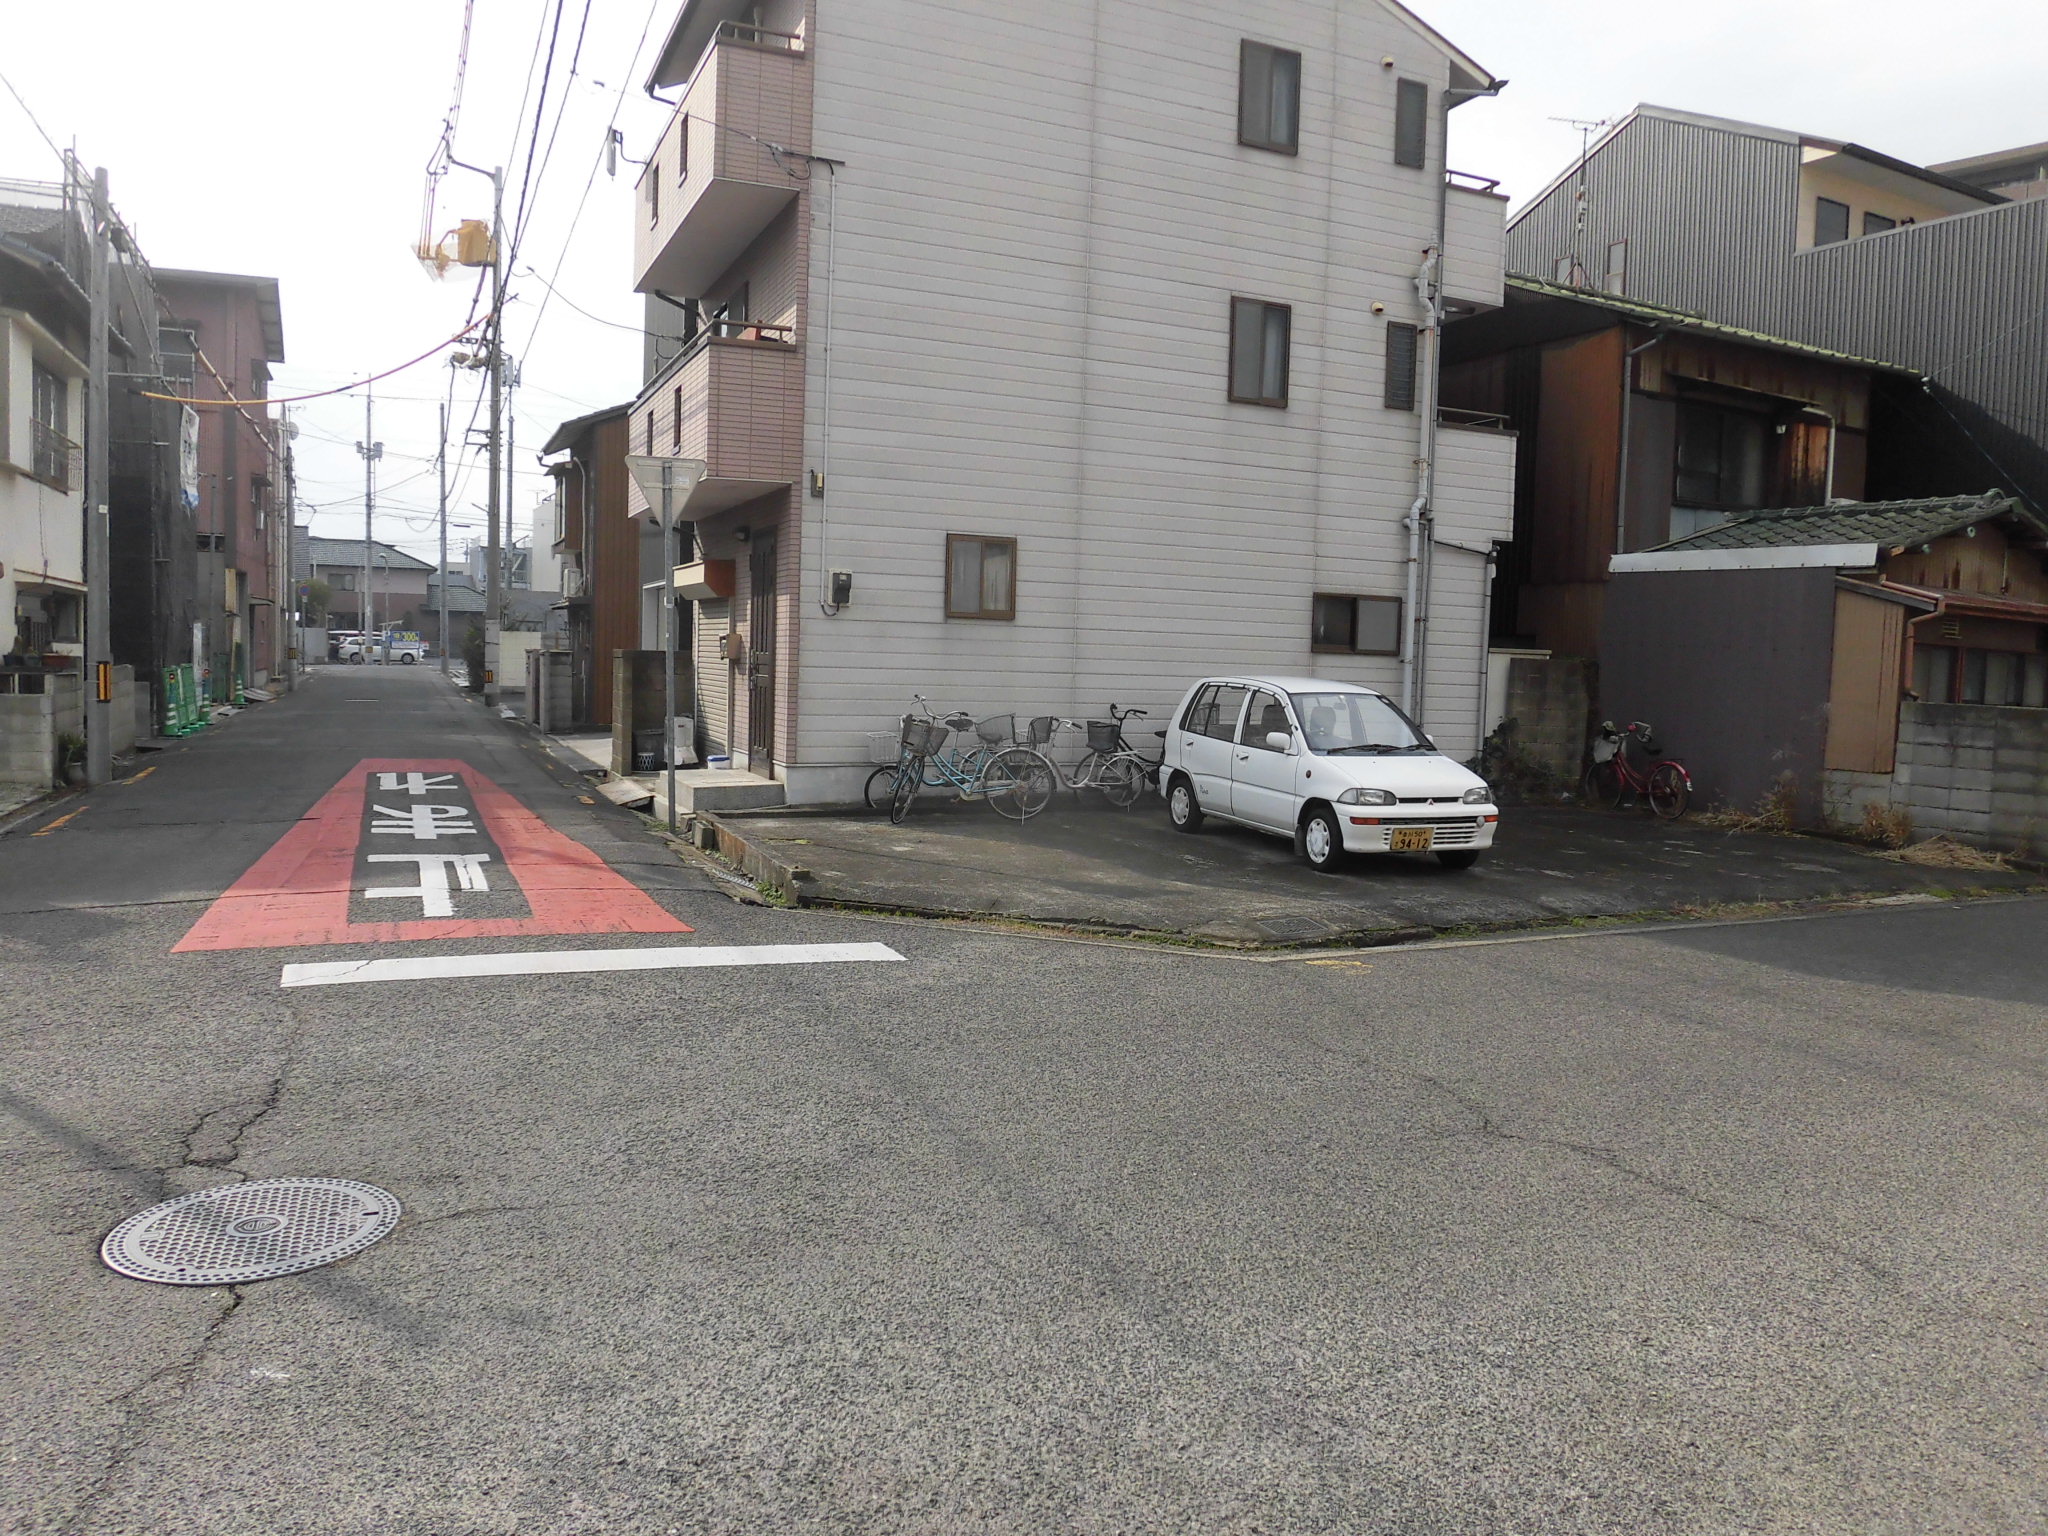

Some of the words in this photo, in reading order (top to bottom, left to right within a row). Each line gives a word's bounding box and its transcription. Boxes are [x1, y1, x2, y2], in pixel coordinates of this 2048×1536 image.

[364, 772, 492, 917] 止まれ
[1400, 839, 1428, 849] 94-12
